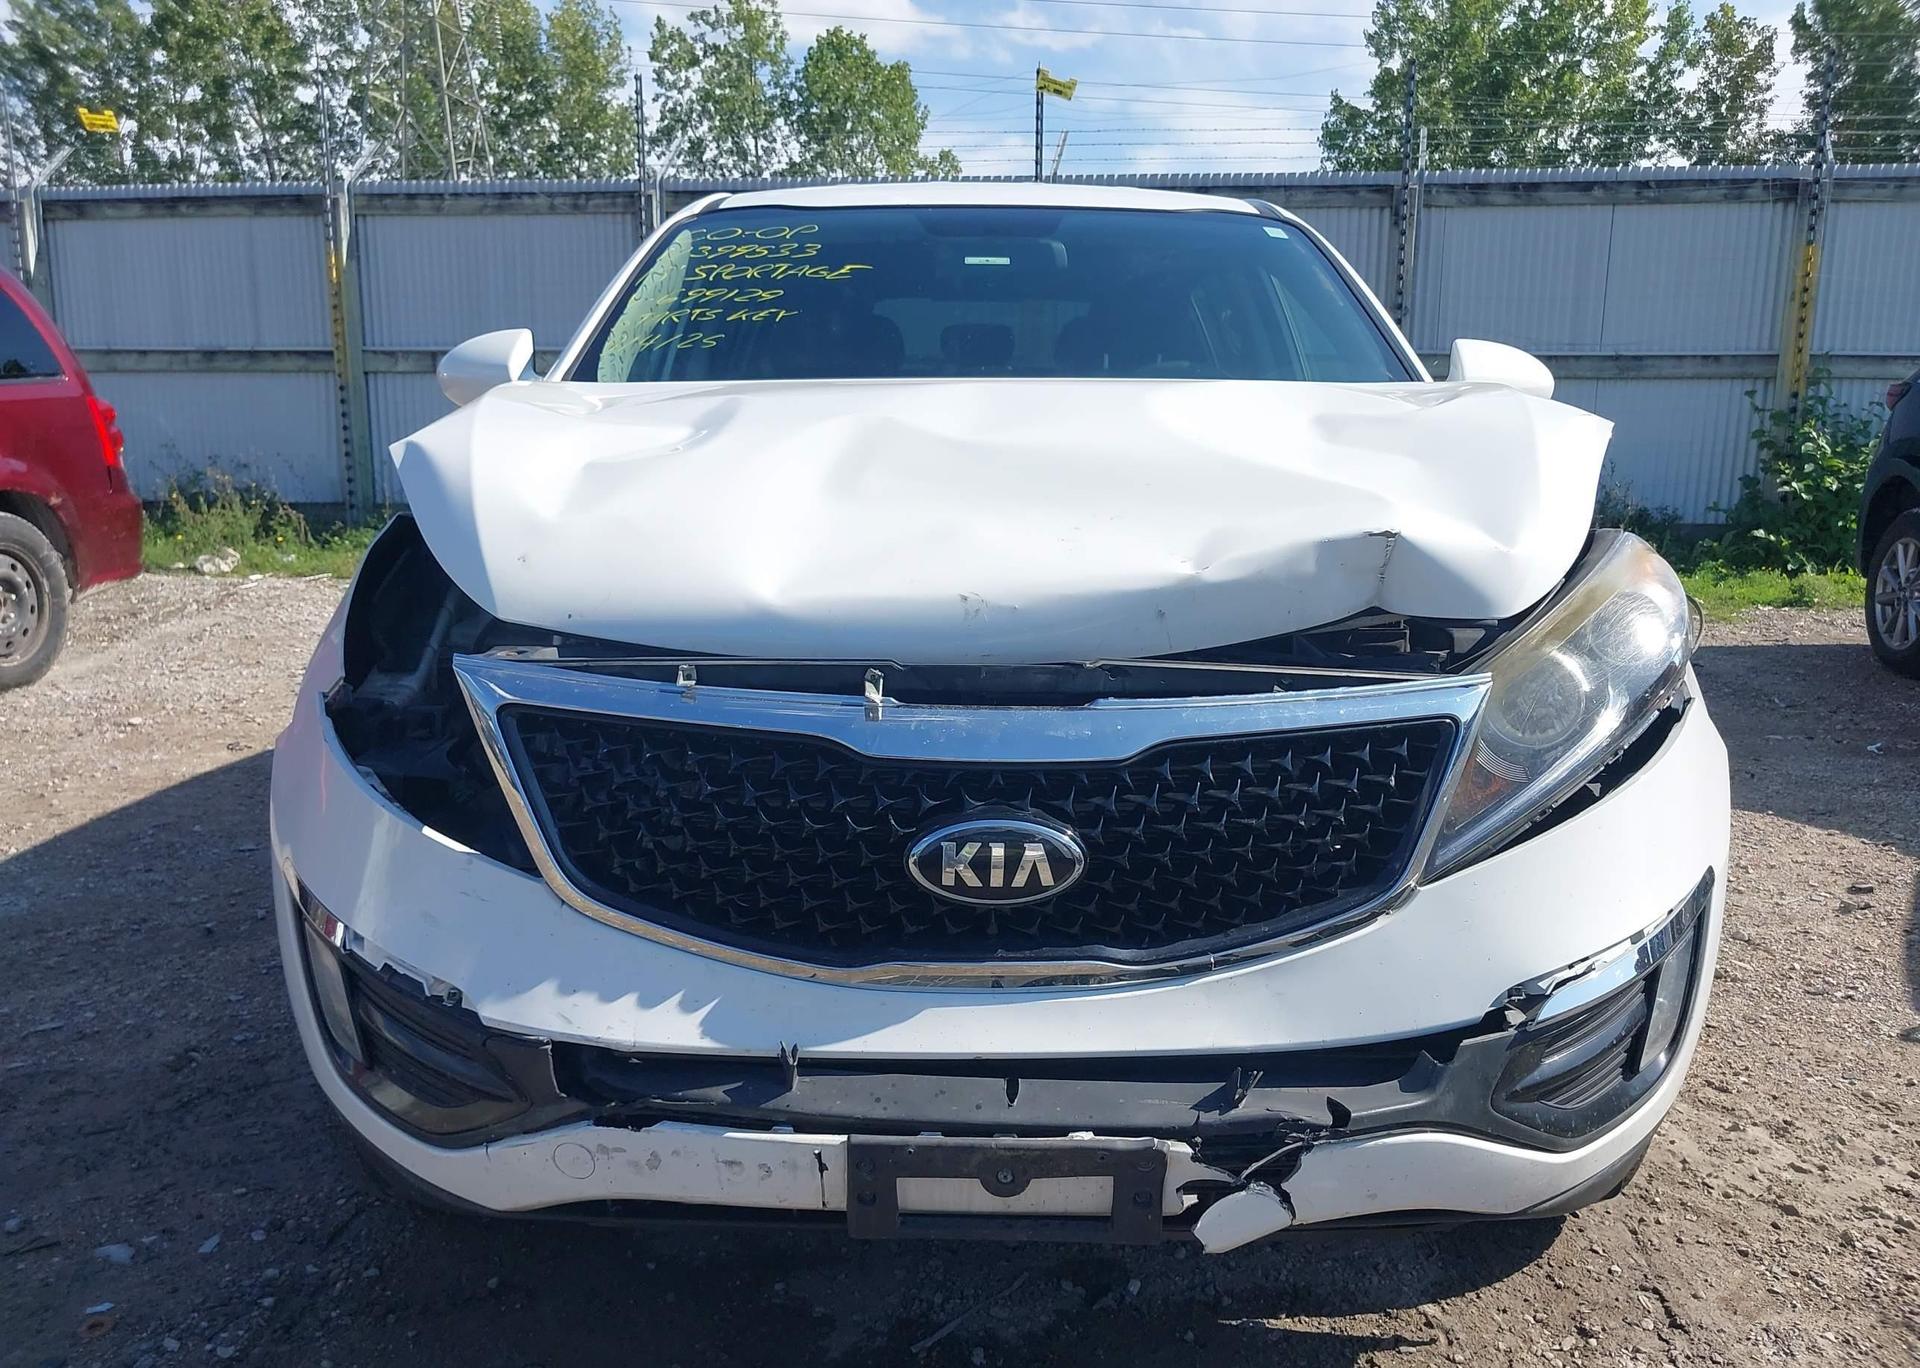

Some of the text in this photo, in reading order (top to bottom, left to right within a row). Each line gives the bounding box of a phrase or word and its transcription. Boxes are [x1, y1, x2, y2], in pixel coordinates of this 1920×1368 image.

[684, 263, 873, 281] SPORTAGE
[726, 308, 800, 323] KEY
[940, 841, 1055, 887] KIA
